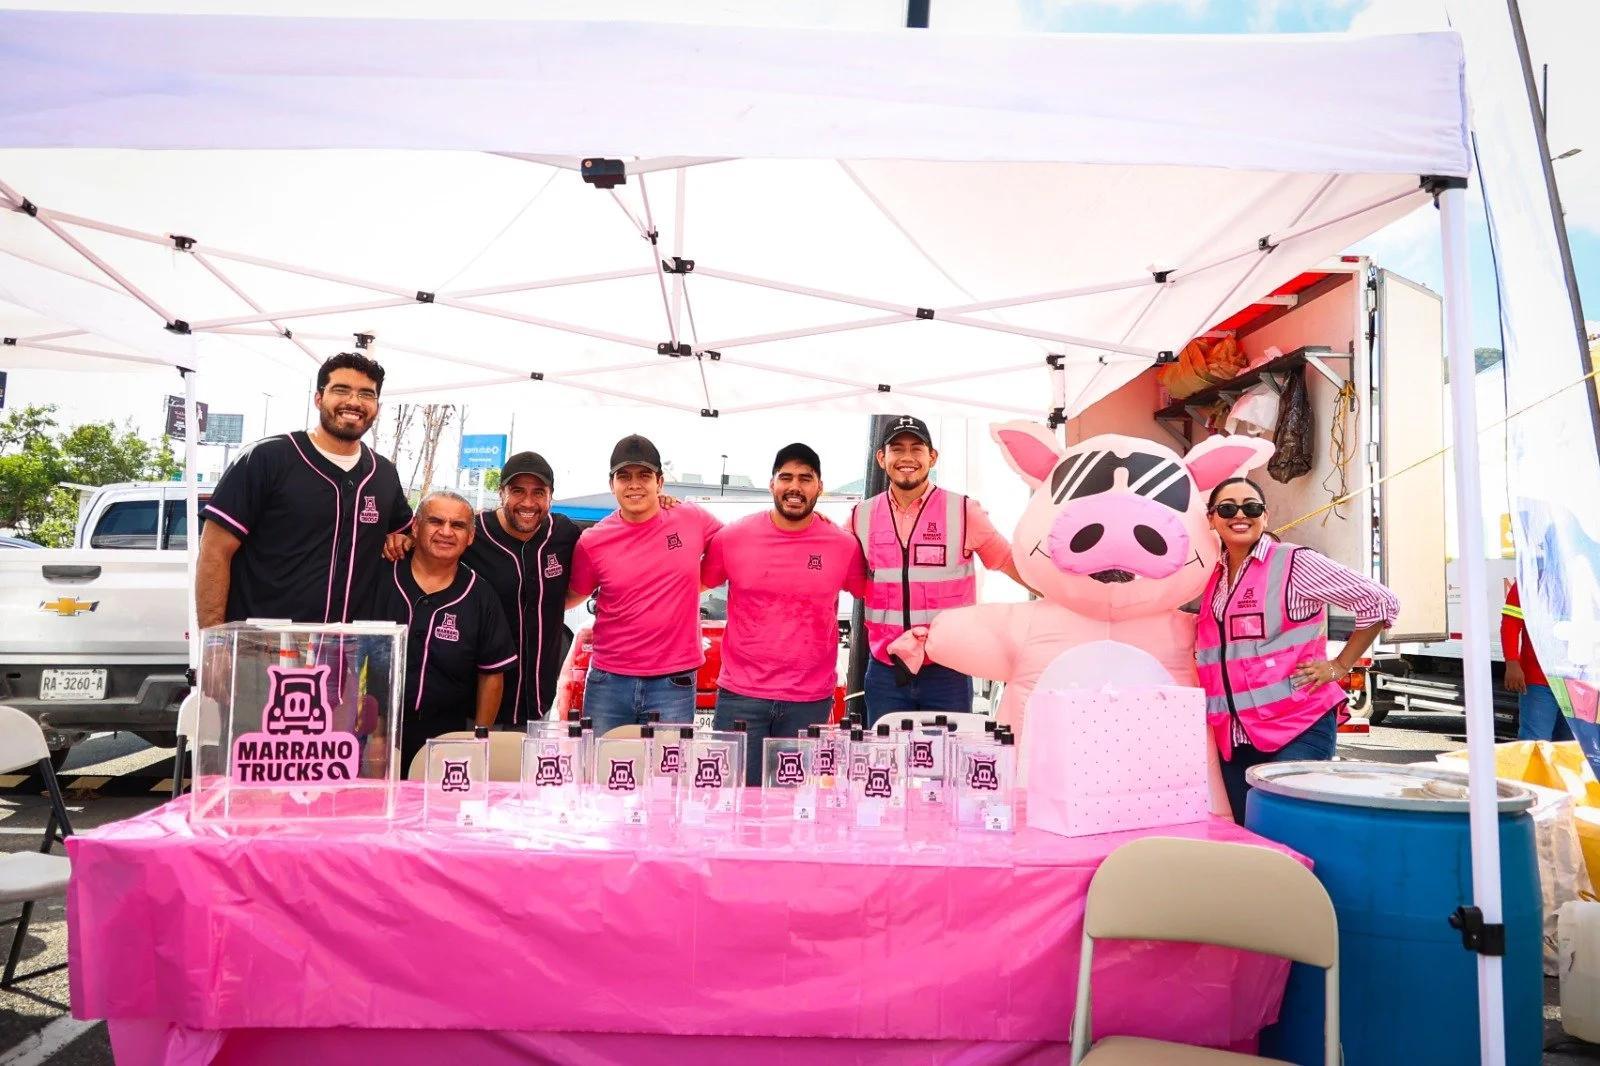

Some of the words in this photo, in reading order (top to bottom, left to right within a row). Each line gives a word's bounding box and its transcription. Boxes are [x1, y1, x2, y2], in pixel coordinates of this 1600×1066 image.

[43, 677, 103, 691] RA-3260-A
[238, 741, 352, 760] MARRANO
[238, 762, 323, 782] TRUCKS
